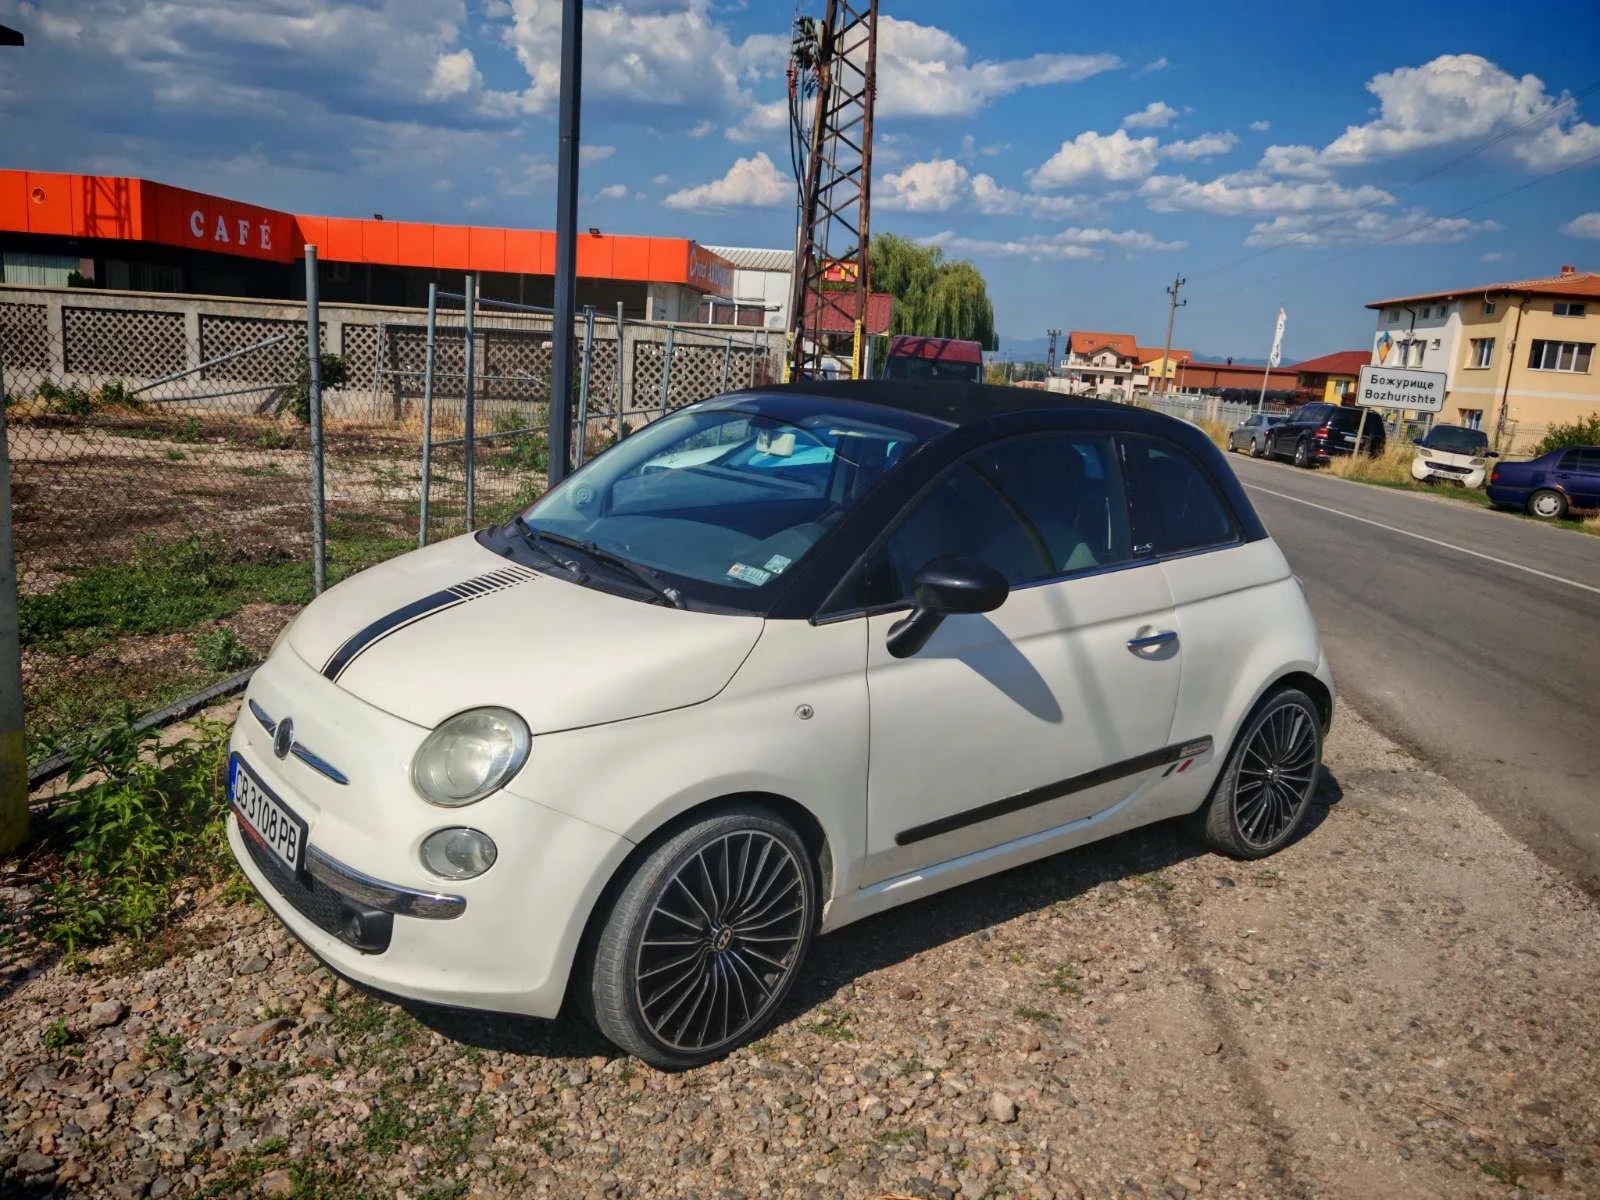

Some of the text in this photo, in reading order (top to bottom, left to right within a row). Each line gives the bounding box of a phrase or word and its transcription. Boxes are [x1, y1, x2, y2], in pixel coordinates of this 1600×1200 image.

[190, 209, 272, 250] CAFÉ
[1370, 374, 1434, 390] Божурище
[1365, 389, 1437, 404] Bozhurishte
